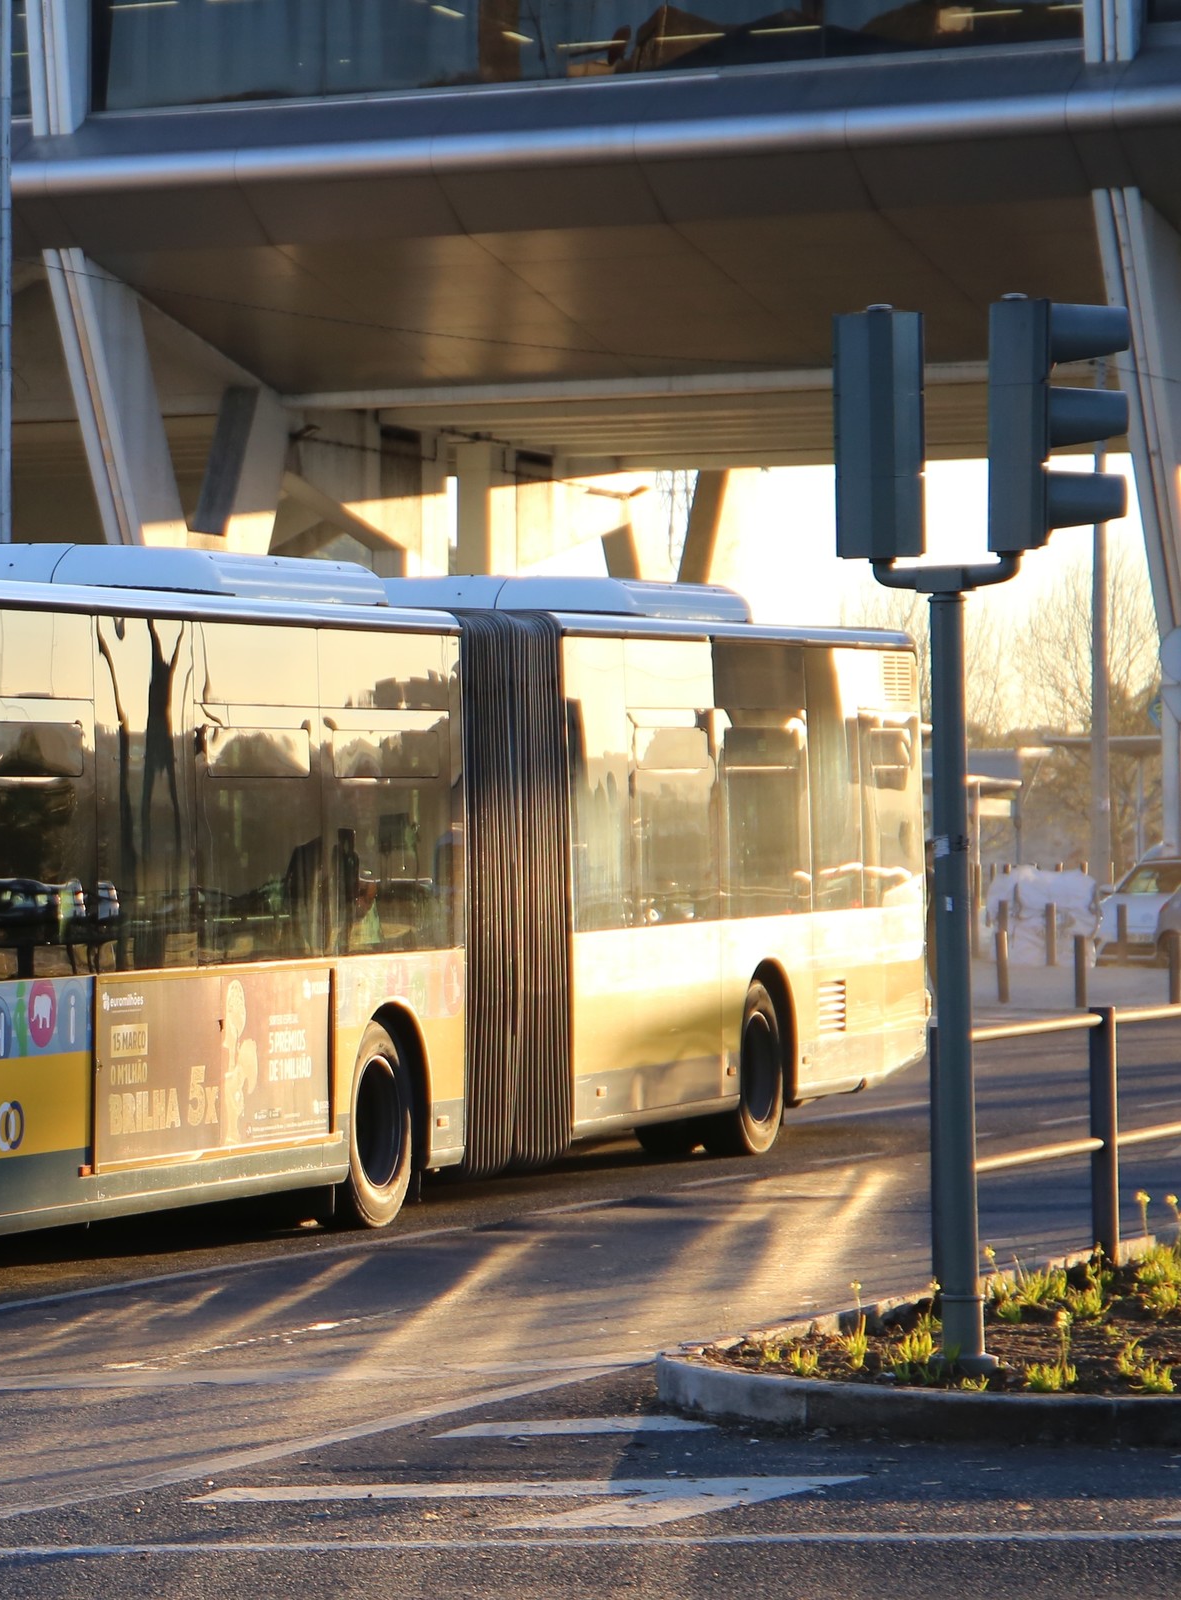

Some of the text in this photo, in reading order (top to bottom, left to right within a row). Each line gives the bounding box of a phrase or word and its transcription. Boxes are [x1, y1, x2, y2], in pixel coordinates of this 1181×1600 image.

[113, 1029, 146, 1053] 15 MARÇO
[269, 1026, 306, 1054] 5 PRÉMIOS
[269, 1059, 279, 1082] DE
[108, 1087, 181, 1136] BRILHA
